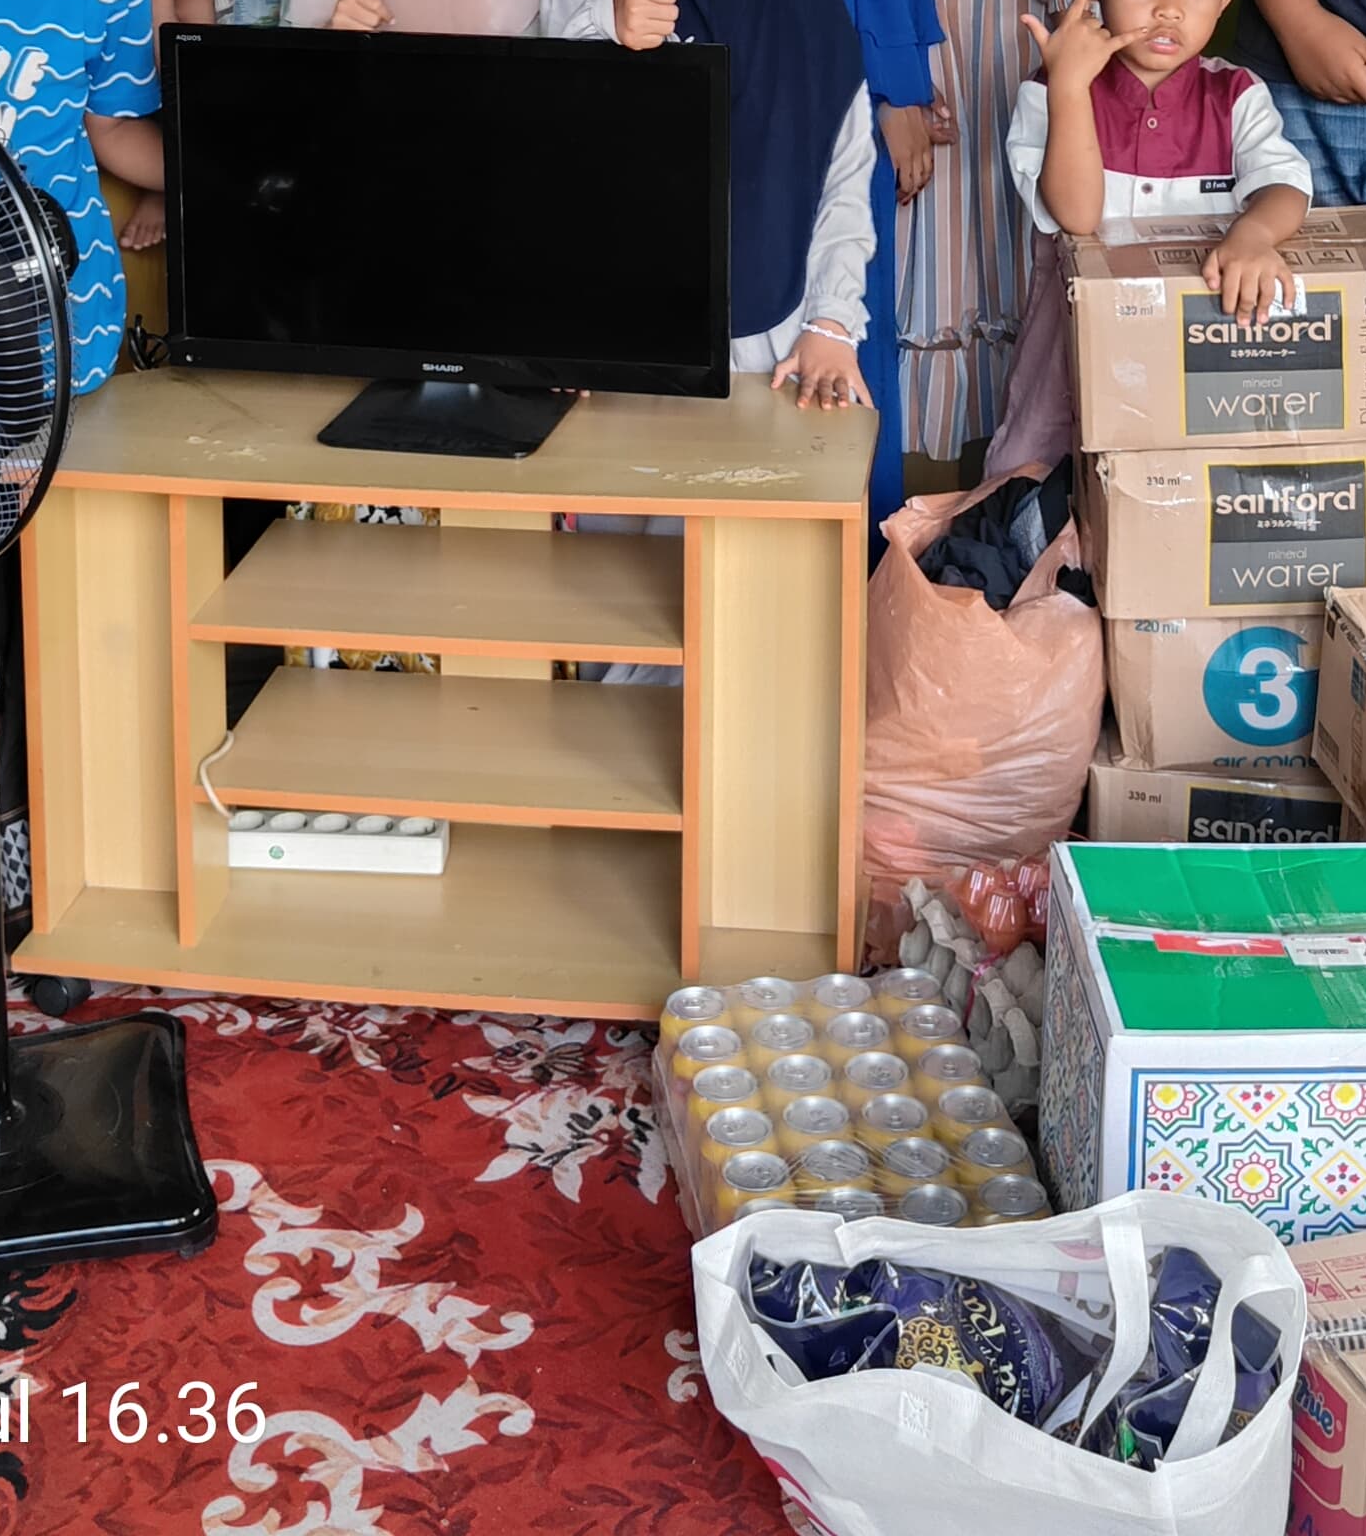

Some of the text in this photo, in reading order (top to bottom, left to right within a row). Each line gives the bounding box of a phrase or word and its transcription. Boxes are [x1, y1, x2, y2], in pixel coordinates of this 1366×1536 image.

[175, 34, 202, 42] AQUOS
[1140, 305, 1153, 315] ml
[422, 363, 464, 373] SHARP
[1242, 375, 1284, 389] mineral
[1206, 390, 1322, 418] water
[1167, 475, 1181, 487] ml
[1215, 483, 1356, 515] sanford
[1267, 547, 1308, 561] mineral
[1232, 562, 1345, 589] water
[1238, 646, 1298, 730] 3
[1149, 792, 1162, 805] ml
[1193, 817, 1334, 843] sanford
